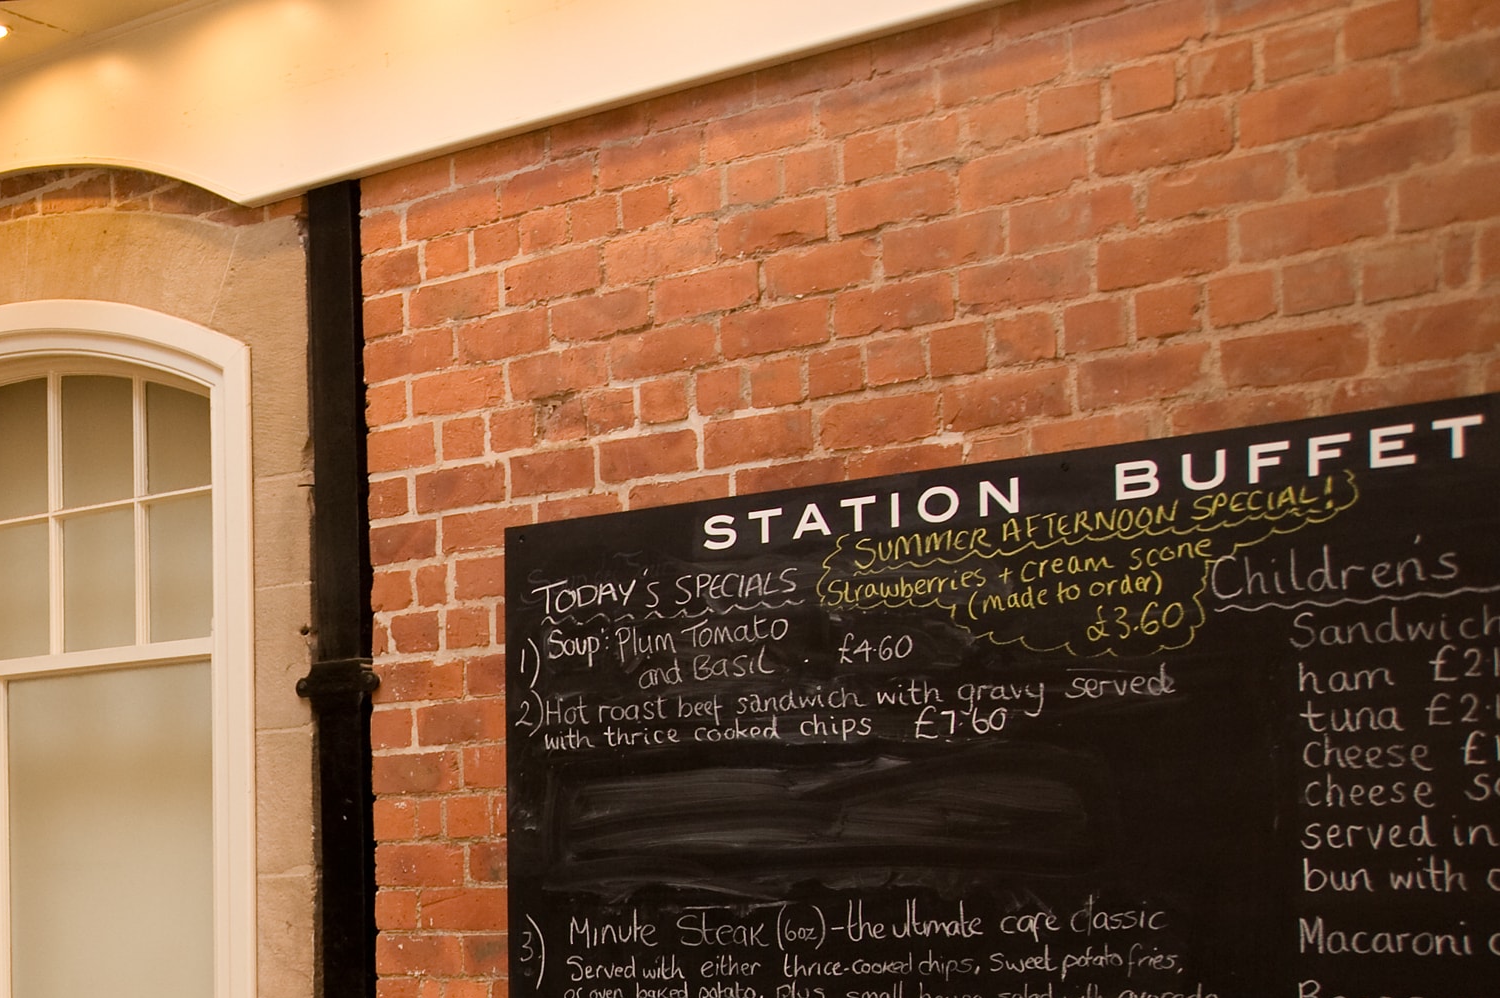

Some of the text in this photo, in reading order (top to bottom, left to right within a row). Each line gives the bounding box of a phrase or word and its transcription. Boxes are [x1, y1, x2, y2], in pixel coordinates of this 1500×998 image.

[703, 414, 1484, 551] STATION BUFFET
[854, 475, 1334, 569] SUMMER AFTERNOON SPECIAL!
[827, 537, 1213, 606] Strawberries cream scone
[1211, 535, 1460, 600] Children's
[531, 568, 660, 614] TODAY'S
[675, 567, 798, 606] SPECIALS
[968, 569, 1164, 620] (made to order)
[615, 617, 789, 663] Plum Tomato
[1086, 601, 1185, 642] £3.60
[638, 657, 683, 690] and
[692, 645, 775, 681] Basil
[1298, 661, 1396, 695] ham
[546, 696, 590, 726] Hot
[598, 696, 668, 723] roast
[678, 694, 724, 726] beef
[735, 685, 867, 716] sandwich
[876, 679, 944, 706] with
[957, 681, 1045, 718] gravy
[1299, 699, 1405, 733] tuna
[544, 728, 596, 751] with
[603, 726, 681, 748] thrice
[694, 714, 781, 743] cooked
[799, 713, 873, 742] chips
[1300, 815, 1438, 850] served
[1302, 855, 1468, 893] bun with
[568, 894, 1169, 949] Minute Steak ultimate cafe classic
[1298, 915, 1473, 956] Macaroni
[566, 955, 637, 982] Served
[641, 957, 686, 981] with
[699, 954, 762, 978] either
[918, 949, 981, 981] chips,
[1061, 943, 1124, 982] potato
